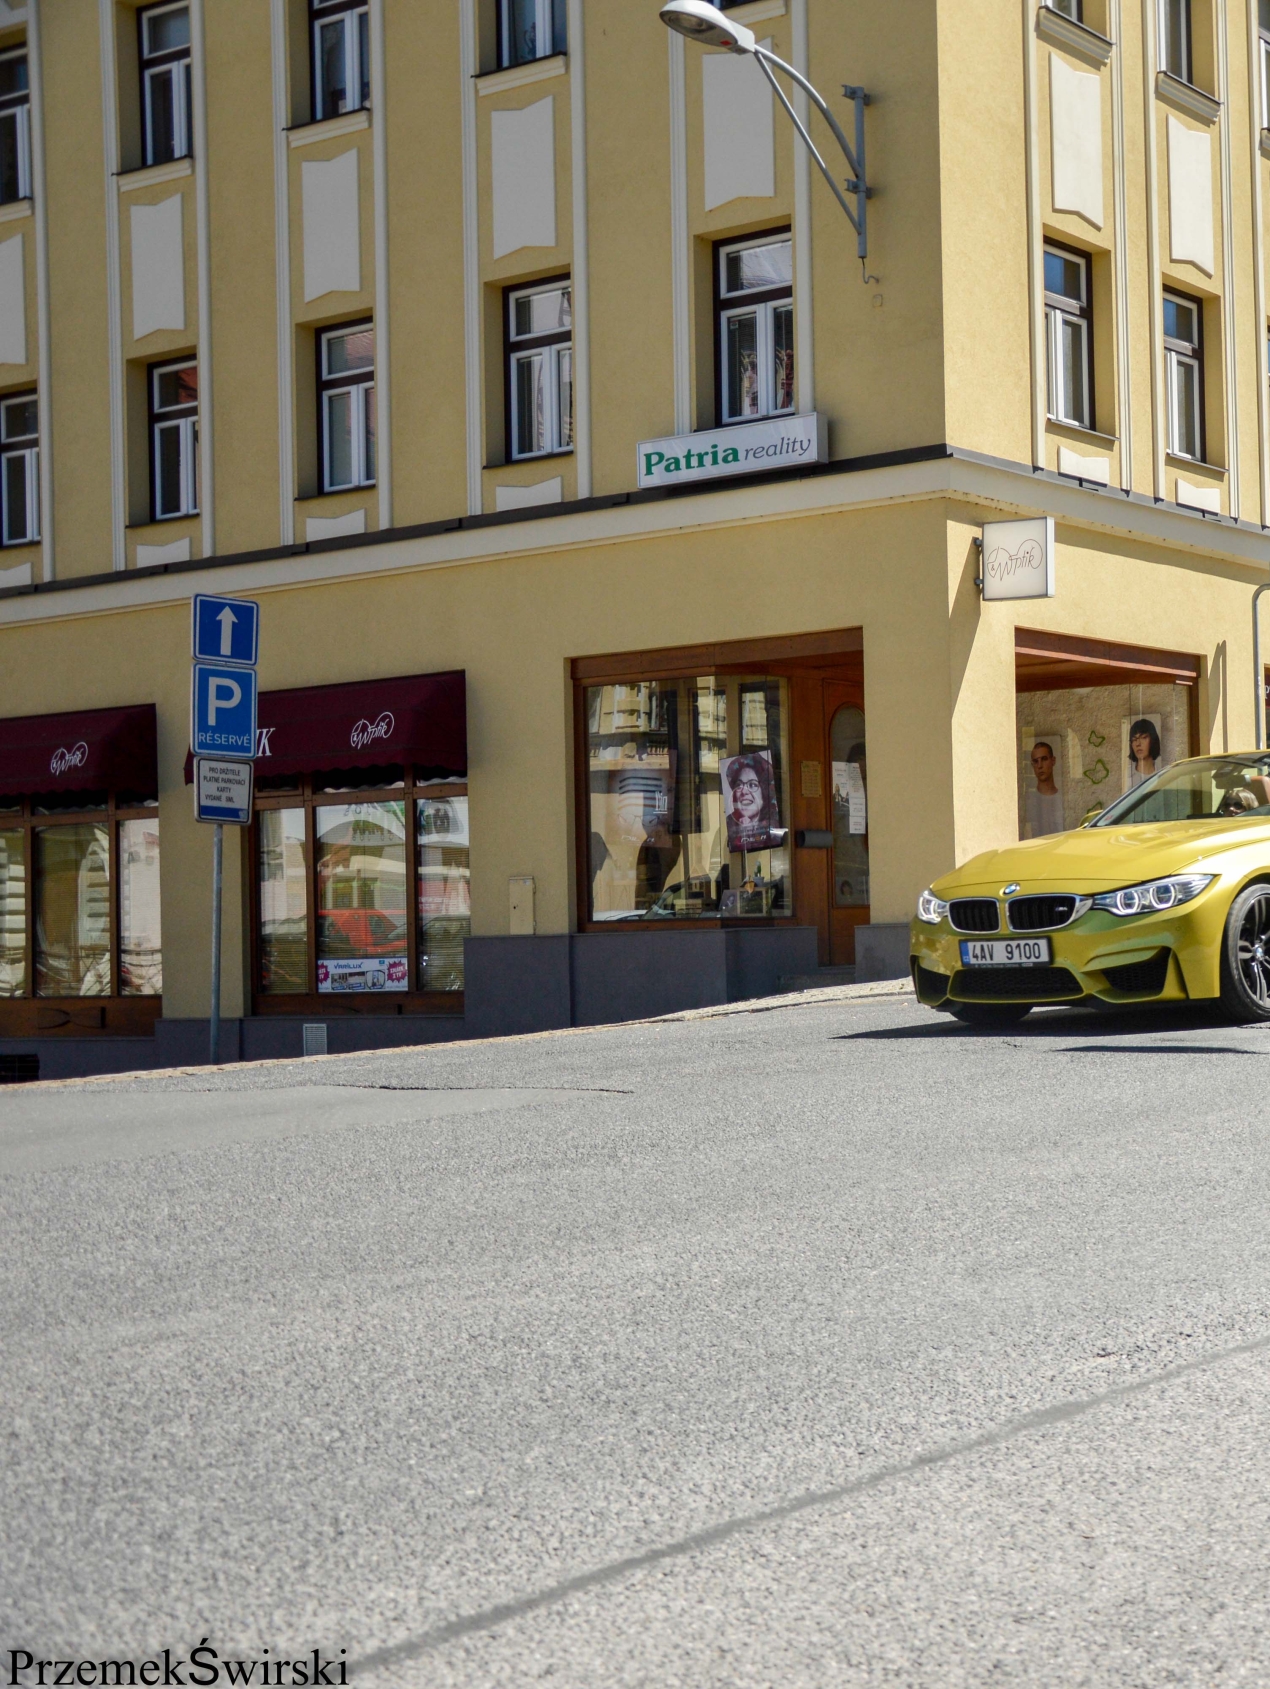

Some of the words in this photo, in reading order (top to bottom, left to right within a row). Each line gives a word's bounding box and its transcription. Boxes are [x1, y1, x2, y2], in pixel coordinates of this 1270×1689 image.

[643, 443, 740, 477] Patria
[744, 437, 811, 461] reality
[208, 676, 242, 726] P
[198, 731, 251, 747] RÉSERVÉ
[208, 766, 218, 775] PRO
[216, 786, 231, 794] KARTY
[972, 943, 994, 962] 4AV
[1005, 942, 1041, 961] 9100
